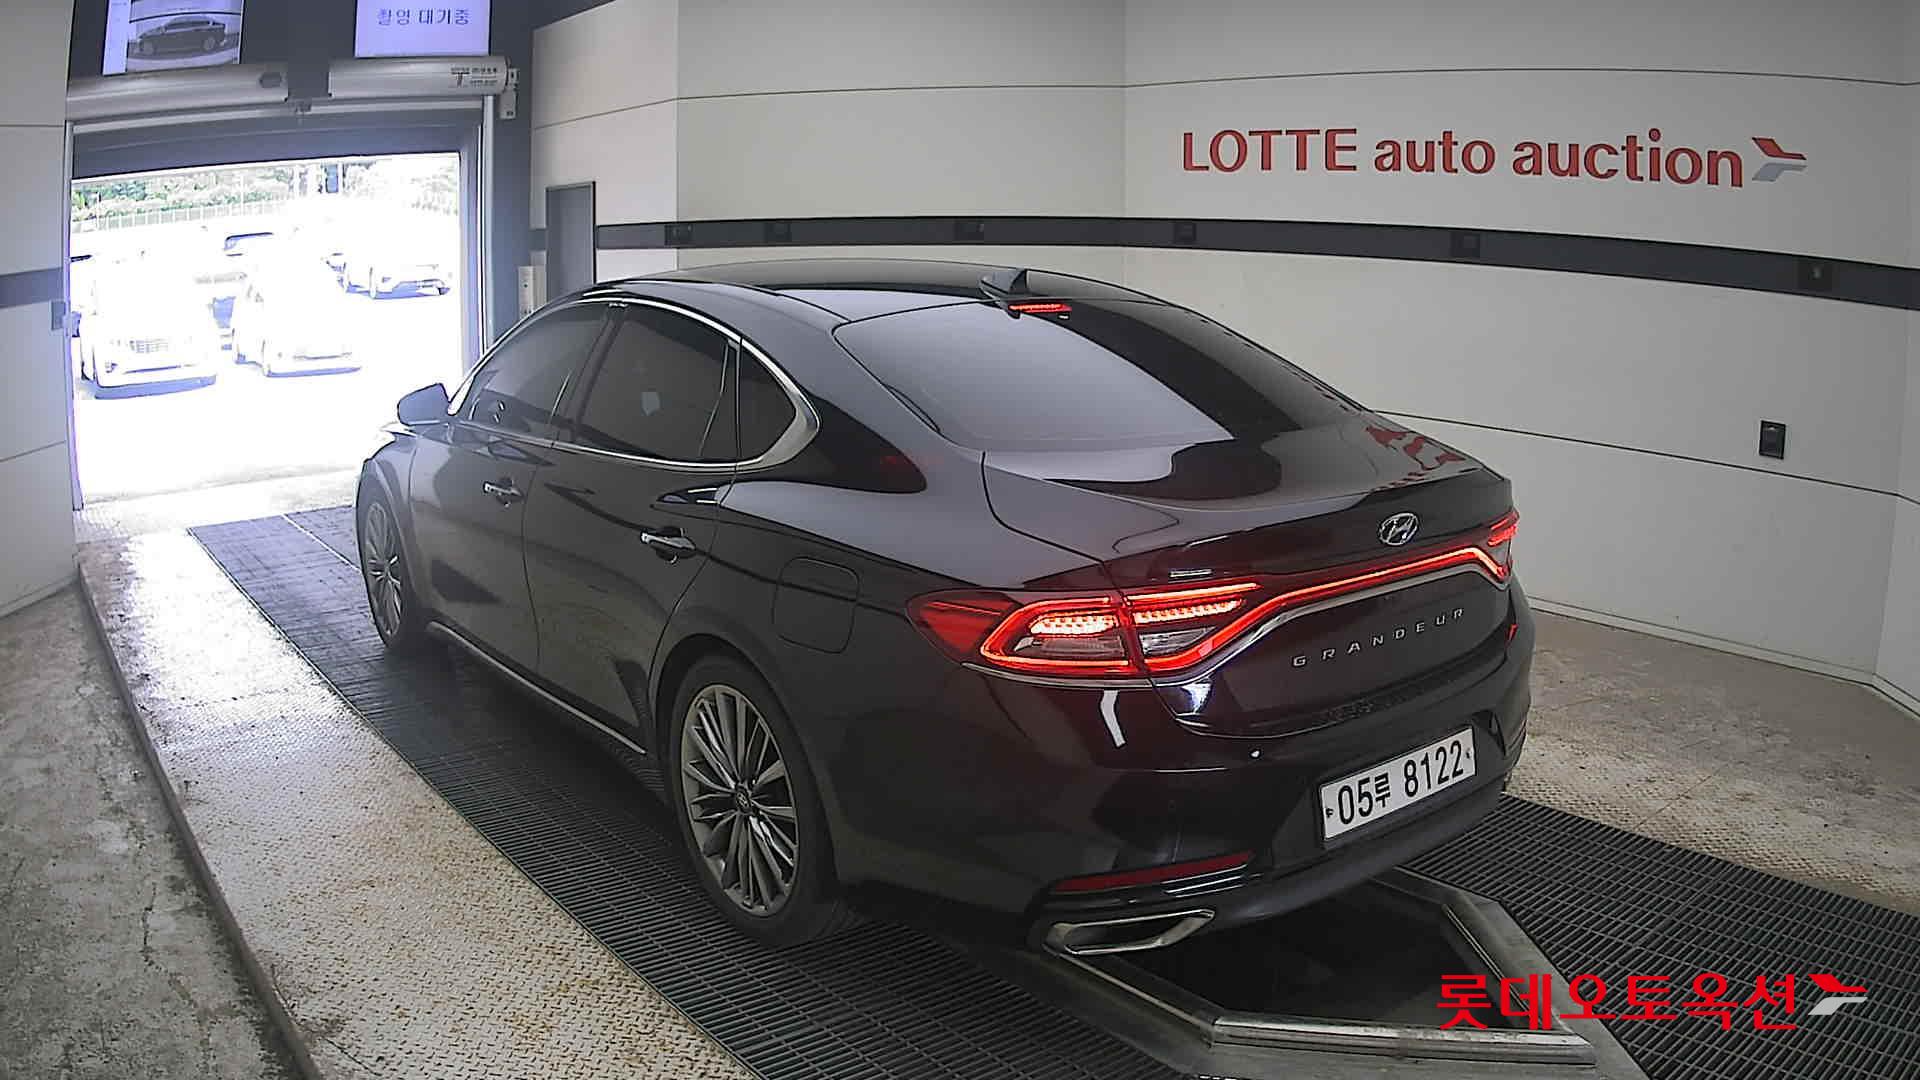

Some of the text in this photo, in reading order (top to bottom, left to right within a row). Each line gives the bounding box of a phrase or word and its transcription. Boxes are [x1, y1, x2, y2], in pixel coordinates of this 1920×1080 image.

[418, 8, 470, 26] 대기중
[1182, 128, 1743, 188] LOTTE auto auction
[1292, 608, 1464, 667] GRANDEUR
[1337, 740, 1464, 825] 05루 8122
